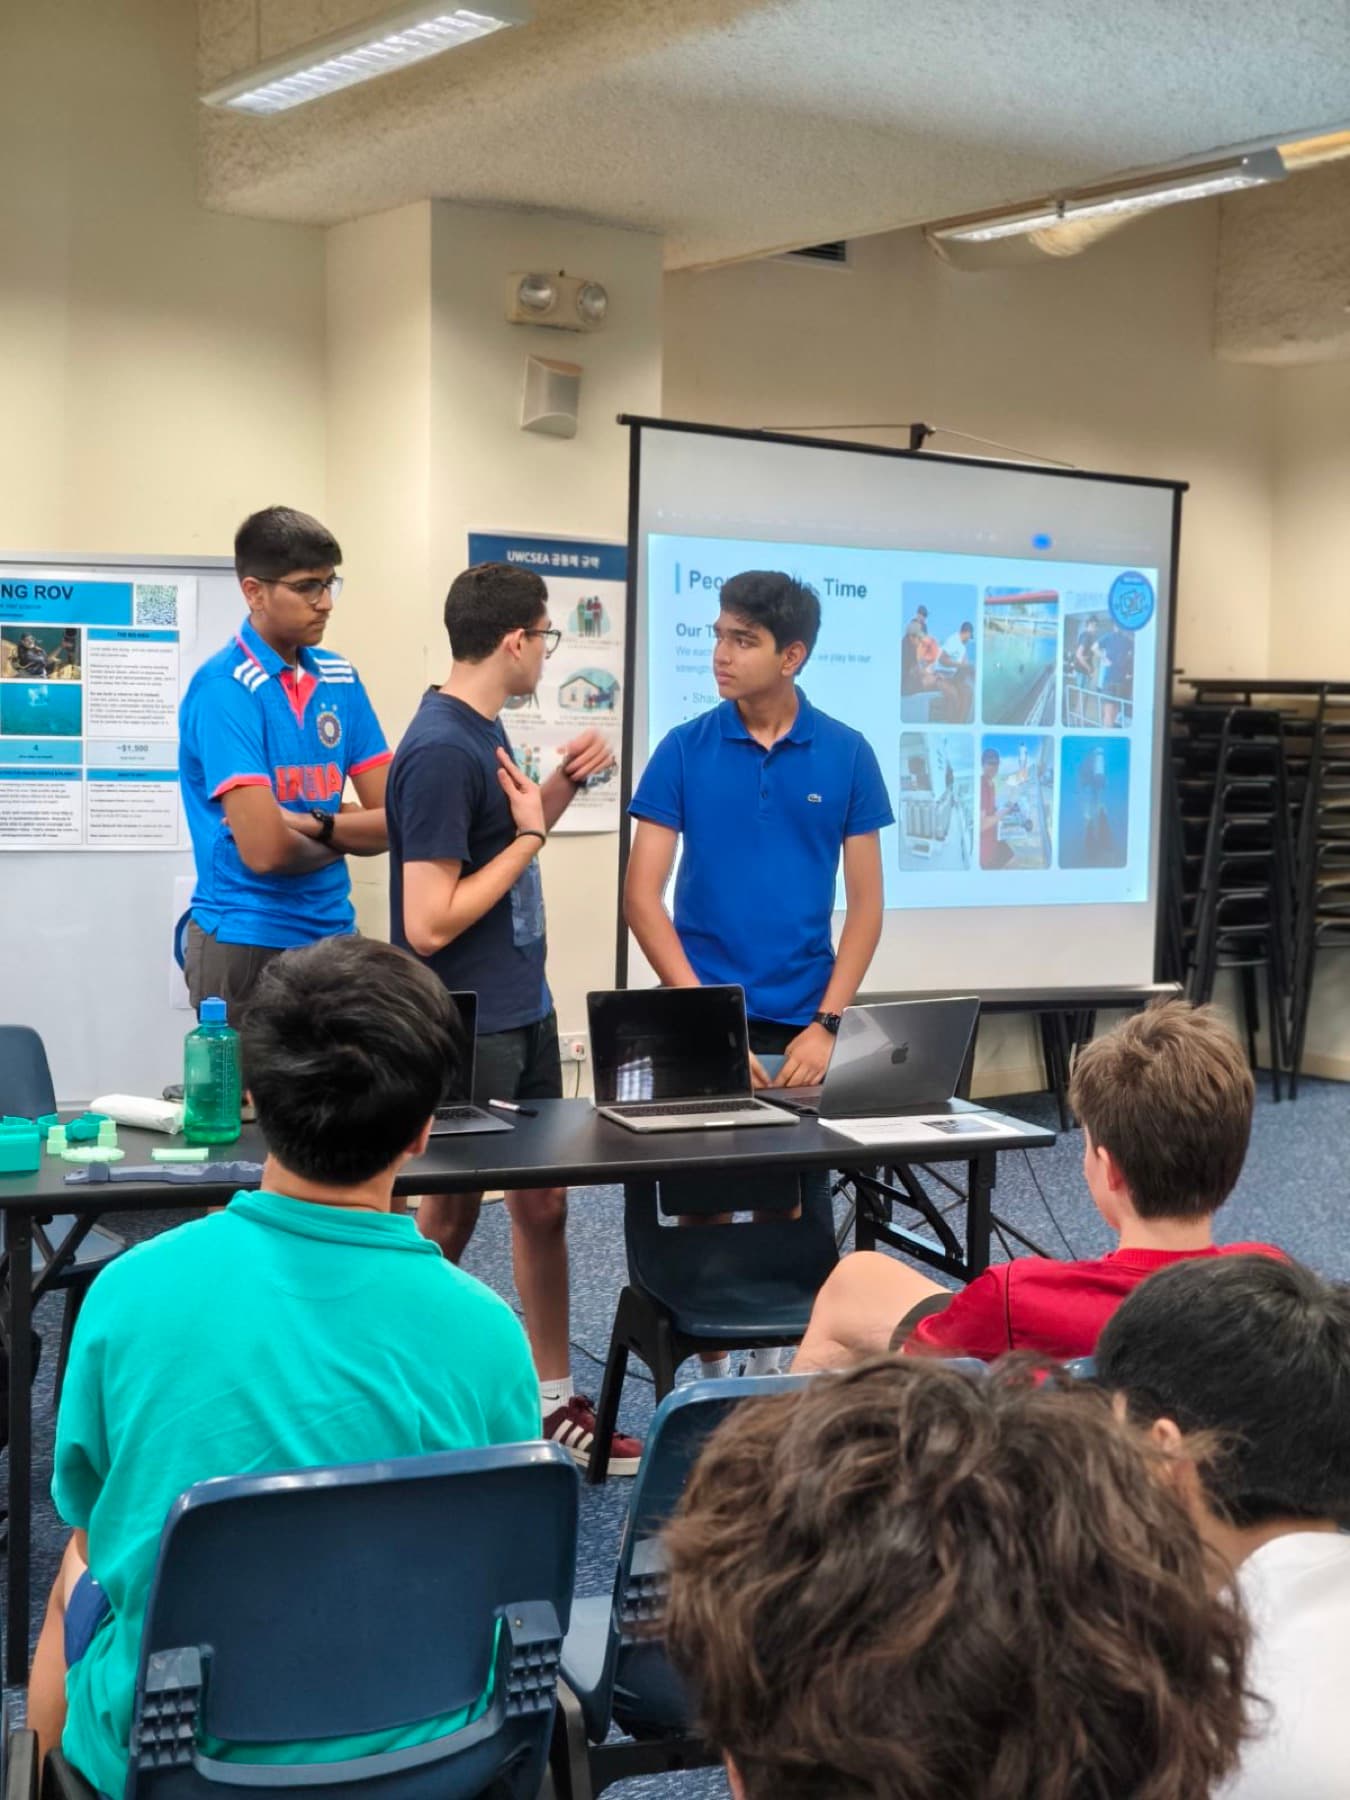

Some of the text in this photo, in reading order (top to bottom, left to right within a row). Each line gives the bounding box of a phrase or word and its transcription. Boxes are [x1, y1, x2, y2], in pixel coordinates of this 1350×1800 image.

[507, 550, 549, 565] UWCSEA
[689, 570, 724, 591] Peo
[823, 578, 868, 598] Time
[1, 584, 74, 600] NG ROV
[676, 622, 703, 638] Our
[275, 762, 343, 801] INDIA
